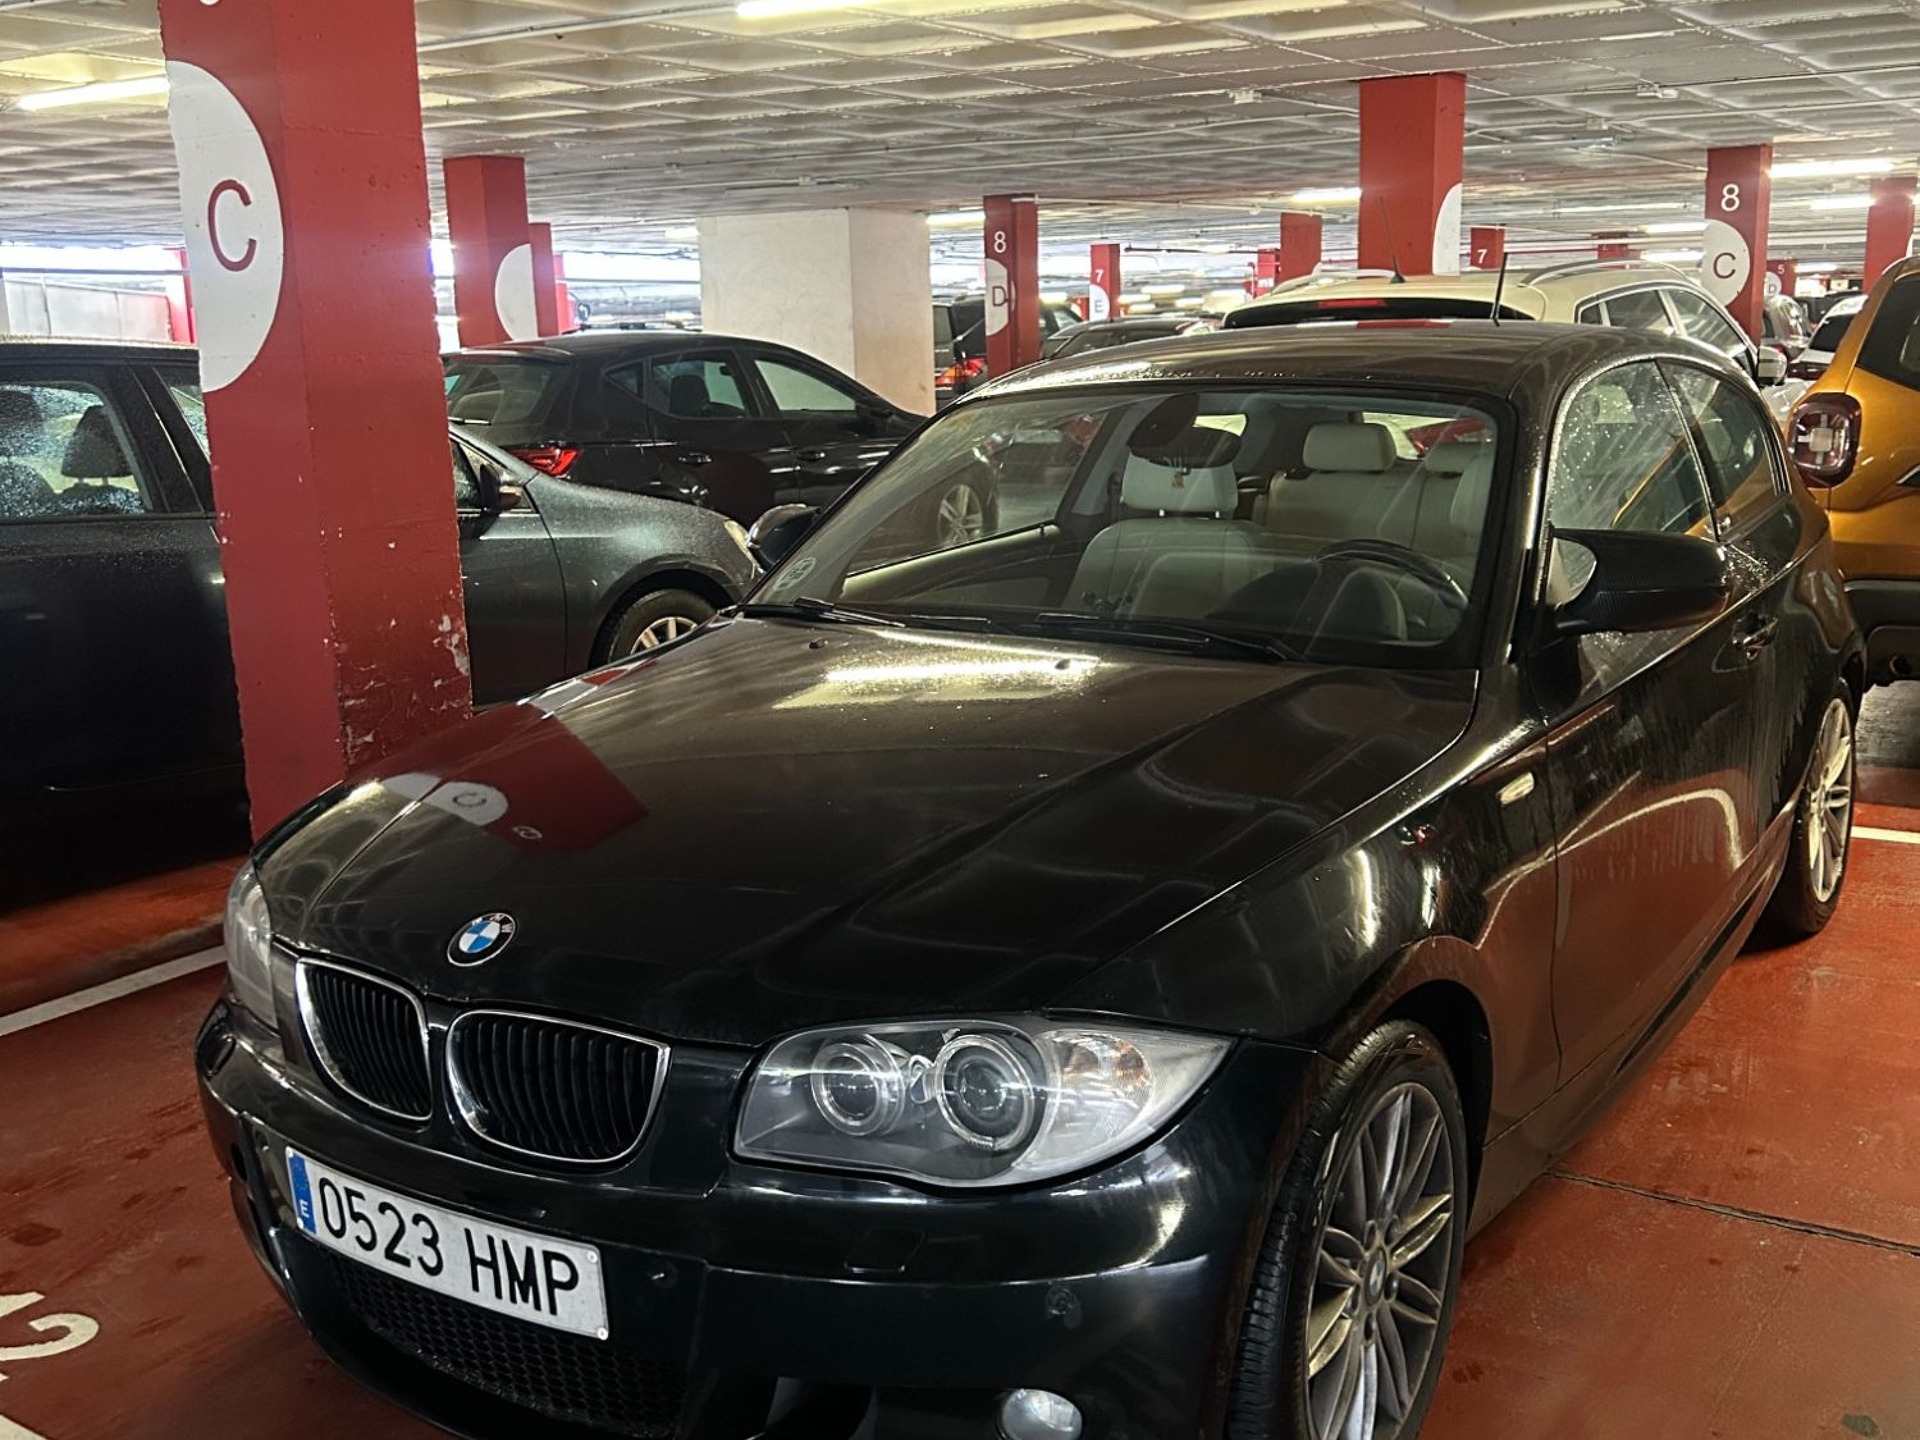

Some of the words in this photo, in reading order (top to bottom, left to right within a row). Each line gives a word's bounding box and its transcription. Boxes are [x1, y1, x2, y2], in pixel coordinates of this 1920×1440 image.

[1721, 184, 1740, 212] 8
[207, 179, 257, 272] C
[994, 231, 1006, 253] 8
[1477, 249, 1487, 264] 7
[1713, 253, 1736, 279] C
[1095, 269, 1103, 282] 7
[992, 286, 1006, 307] D
[299, 1199, 309, 1218] E
[319, 1177, 444, 1277] 0523
[464, 1227, 580, 1316] HMP
